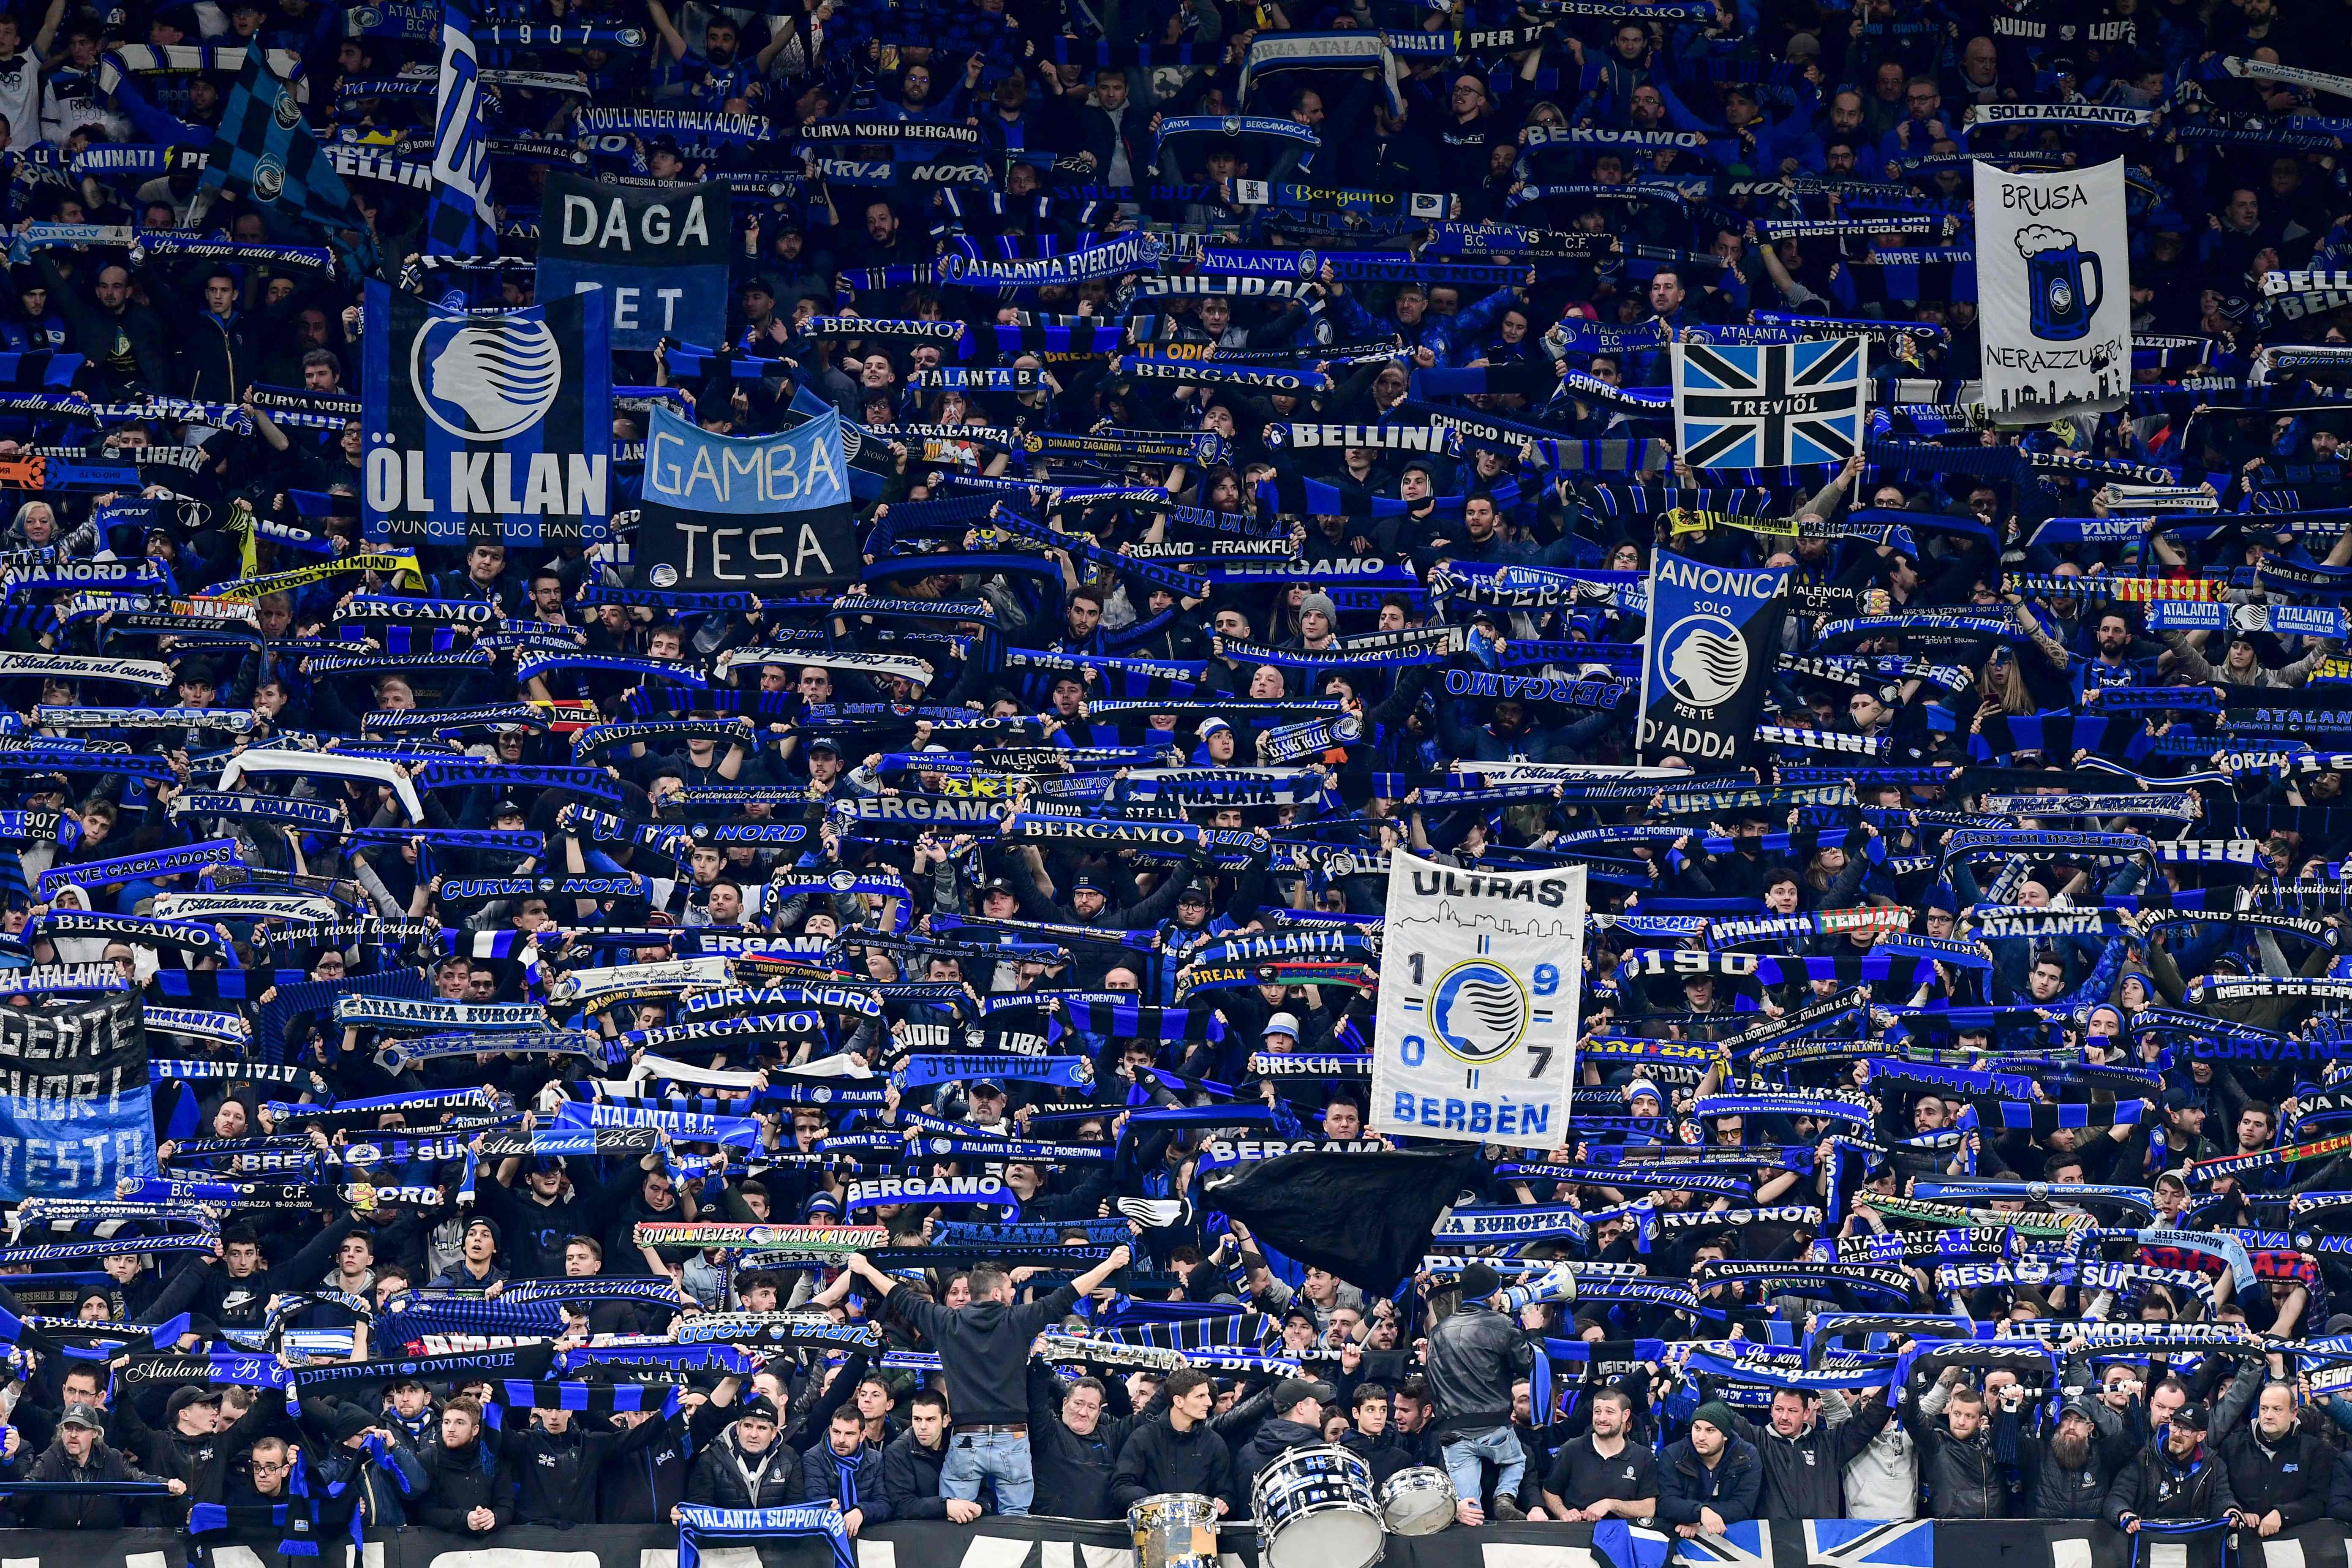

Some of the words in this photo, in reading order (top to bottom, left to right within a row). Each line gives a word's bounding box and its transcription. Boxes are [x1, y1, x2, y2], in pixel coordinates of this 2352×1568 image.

[1560, 1, 1685, 18] BERGAMO
[1470, 29, 1515, 49] PER
[587, 109, 629, 130] YOU'LL
[634, 109, 674, 129] NEVER
[678, 112, 713, 131] WALK
[715, 114, 758, 136] ALONE
[1989, 106, 2038, 120] SOLO
[2042, 106, 2137, 124] ATALANTA
[801, 124, 850, 138] CURVA
[855, 124, 899, 137] NORD
[905, 125, 977, 143] BERGAMO
[1246, 120, 1304, 136] BERGAMASCA
[513, 143, 551, 155] ATALANTA
[553, 147, 568, 158] B.C.
[1923, 154, 1957, 163] APOLLON
[2008, 150, 2043, 159] ATALANTA
[1285, 184, 1394, 207] Bergamo
[2001, 184, 2088, 217] BRUSA
[562, 194, 710, 251] DAGA
[1769, 230, 1788, 240] DEI
[1793, 226, 1859, 237] NOSTRI
[1867, 225, 1930, 234] COLORI
[968, 258, 1064, 278] ATALANTA
[1070, 242, 1139, 273] EVERTON
[1206, 257, 1294, 272] ATALANTA
[1082, 266, 1129, 280] 14/09/2017
[575, 281, 682, 331] ET
[822, 317, 955, 338] BERGAMO
[1720, 327, 1788, 340] ATALANTA
[1136, 362, 1300, 389] BERGAMO
[9, 395, 47, 411] nella
[50, 398, 91, 416] storia
[254, 392, 308, 408] CURVA
[314, 400, 363, 413] NORD
[1730, 394, 1818, 416] TREVIÖL
[1430, 413, 1498, 440] CHICCO
[1048, 438, 1081, 449] DINAMO
[1083, 442, 1122, 452] ZAGABRIA
[1137, 445, 1176, 455] ATALANTA
[1175, 448, 1190, 456] B.C.
[1291, 423, 1444, 454] BELLINI
[366, 431, 434, 512] ÖL
[451, 452, 607, 517] KLAN
[651, 431, 841, 504] GAMBA
[468, 525, 490, 536] AL
[495, 524, 533, 537] TUO
[539, 523, 607, 538] FIANCO
[676, 522, 834, 580] TESA
[54, 564, 127, 580] NORD
[1655, 558, 1789, 599] ANONICA
[2025, 578, 2107, 592] ATALANTA
[2127, 581, 2208, 596] VALENCIA
[1693, 601, 1732, 617] SOLO
[2163, 602, 2220, 618] ATALANTA
[2276, 607, 2335, 626] ATALANTA
[2164, 617, 2199, 625] BERGAMASCA
[2201, 617, 2220, 626] CALCIO
[2276, 621, 2313, 632] BERGAMASCA
[2314, 623, 2334, 634] CALCIO
[2, 658, 87, 672] l'Atalanta
[90, 662, 119, 675] nel
[1673, 701, 1696, 720] PER
[1699, 708, 1715, 720] TE
[190, 795, 242, 811] FORZA
[250, 800, 330, 822] ATALANTA
[15, 811, 60, 830] 1907
[14, 827, 57, 840] CALCIO
[715, 824, 808, 843] NORD
[1024, 820, 1184, 843] BERGAMO
[44, 872, 71, 893] AN
[76, 866, 101, 883] VE
[106, 860, 156, 877] CAGA
[166, 848, 230, 868] ADOSS
[441, 879, 534, 901] CURVA
[1412, 871, 1568, 908] ULTRAS
[175, 898, 267, 917] l'Atalanta
[272, 901, 298, 912] nel
[55, 915, 210, 946] BERGAMO
[270, 926, 321, 943] curva
[324, 923, 366, 939] nord
[1712, 917, 1813, 940] ATALANTA
[1821, 911, 1909, 928] TERNANA
[1980, 916, 2104, 937] ATALANTA
[1226, 929, 1346, 963] ATALANTA
[1193, 968, 1247, 985] FREAK
[686, 984, 787, 1014] CURVA
[802, 988, 881, 1017] NORD
[2216, 985, 2270, 1000] INSIEME
[2278, 983, 2308, 996] PER
[642, 1012, 813, 1047] BERGAMO
[1256, 1055, 1342, 1075] BRESCIA
[1393, 1090, 1551, 1137] BERBÈN
[1716, 1105, 1750, 1113] PARTITA
[482, 1132, 592, 1155] Atalanta
[593, 1129, 647, 1149] B.C.
[961, 1141, 1003, 1152] ATALANTA
[1007, 1143, 1024, 1154] B.C.
[1040, 1146, 1052, 1156] AC
[1617, 1159, 1640, 1168] Siam
[1643, 1157, 1693, 1168] bergamaschi
[1718, 1157, 1756, 1165] conosciam
[1758, 1157, 1786, 1167] confine
[2196, 1153, 2274, 1182] ATALANTA
[1474, 1209, 1571, 1233] EUROPEA
[691, 1228, 742, 1242] NEVER
[776, 1228, 826, 1244] WALK
[1958, 1227, 2006, 1244] 1907
[1838, 1243, 1945, 1263] BERGAMASCA
[1948, 1244, 2003, 1254] CALCIO
[125, 1359, 223, 1383] Atalanta
[420, 1353, 515, 1372] OVUNQUE
